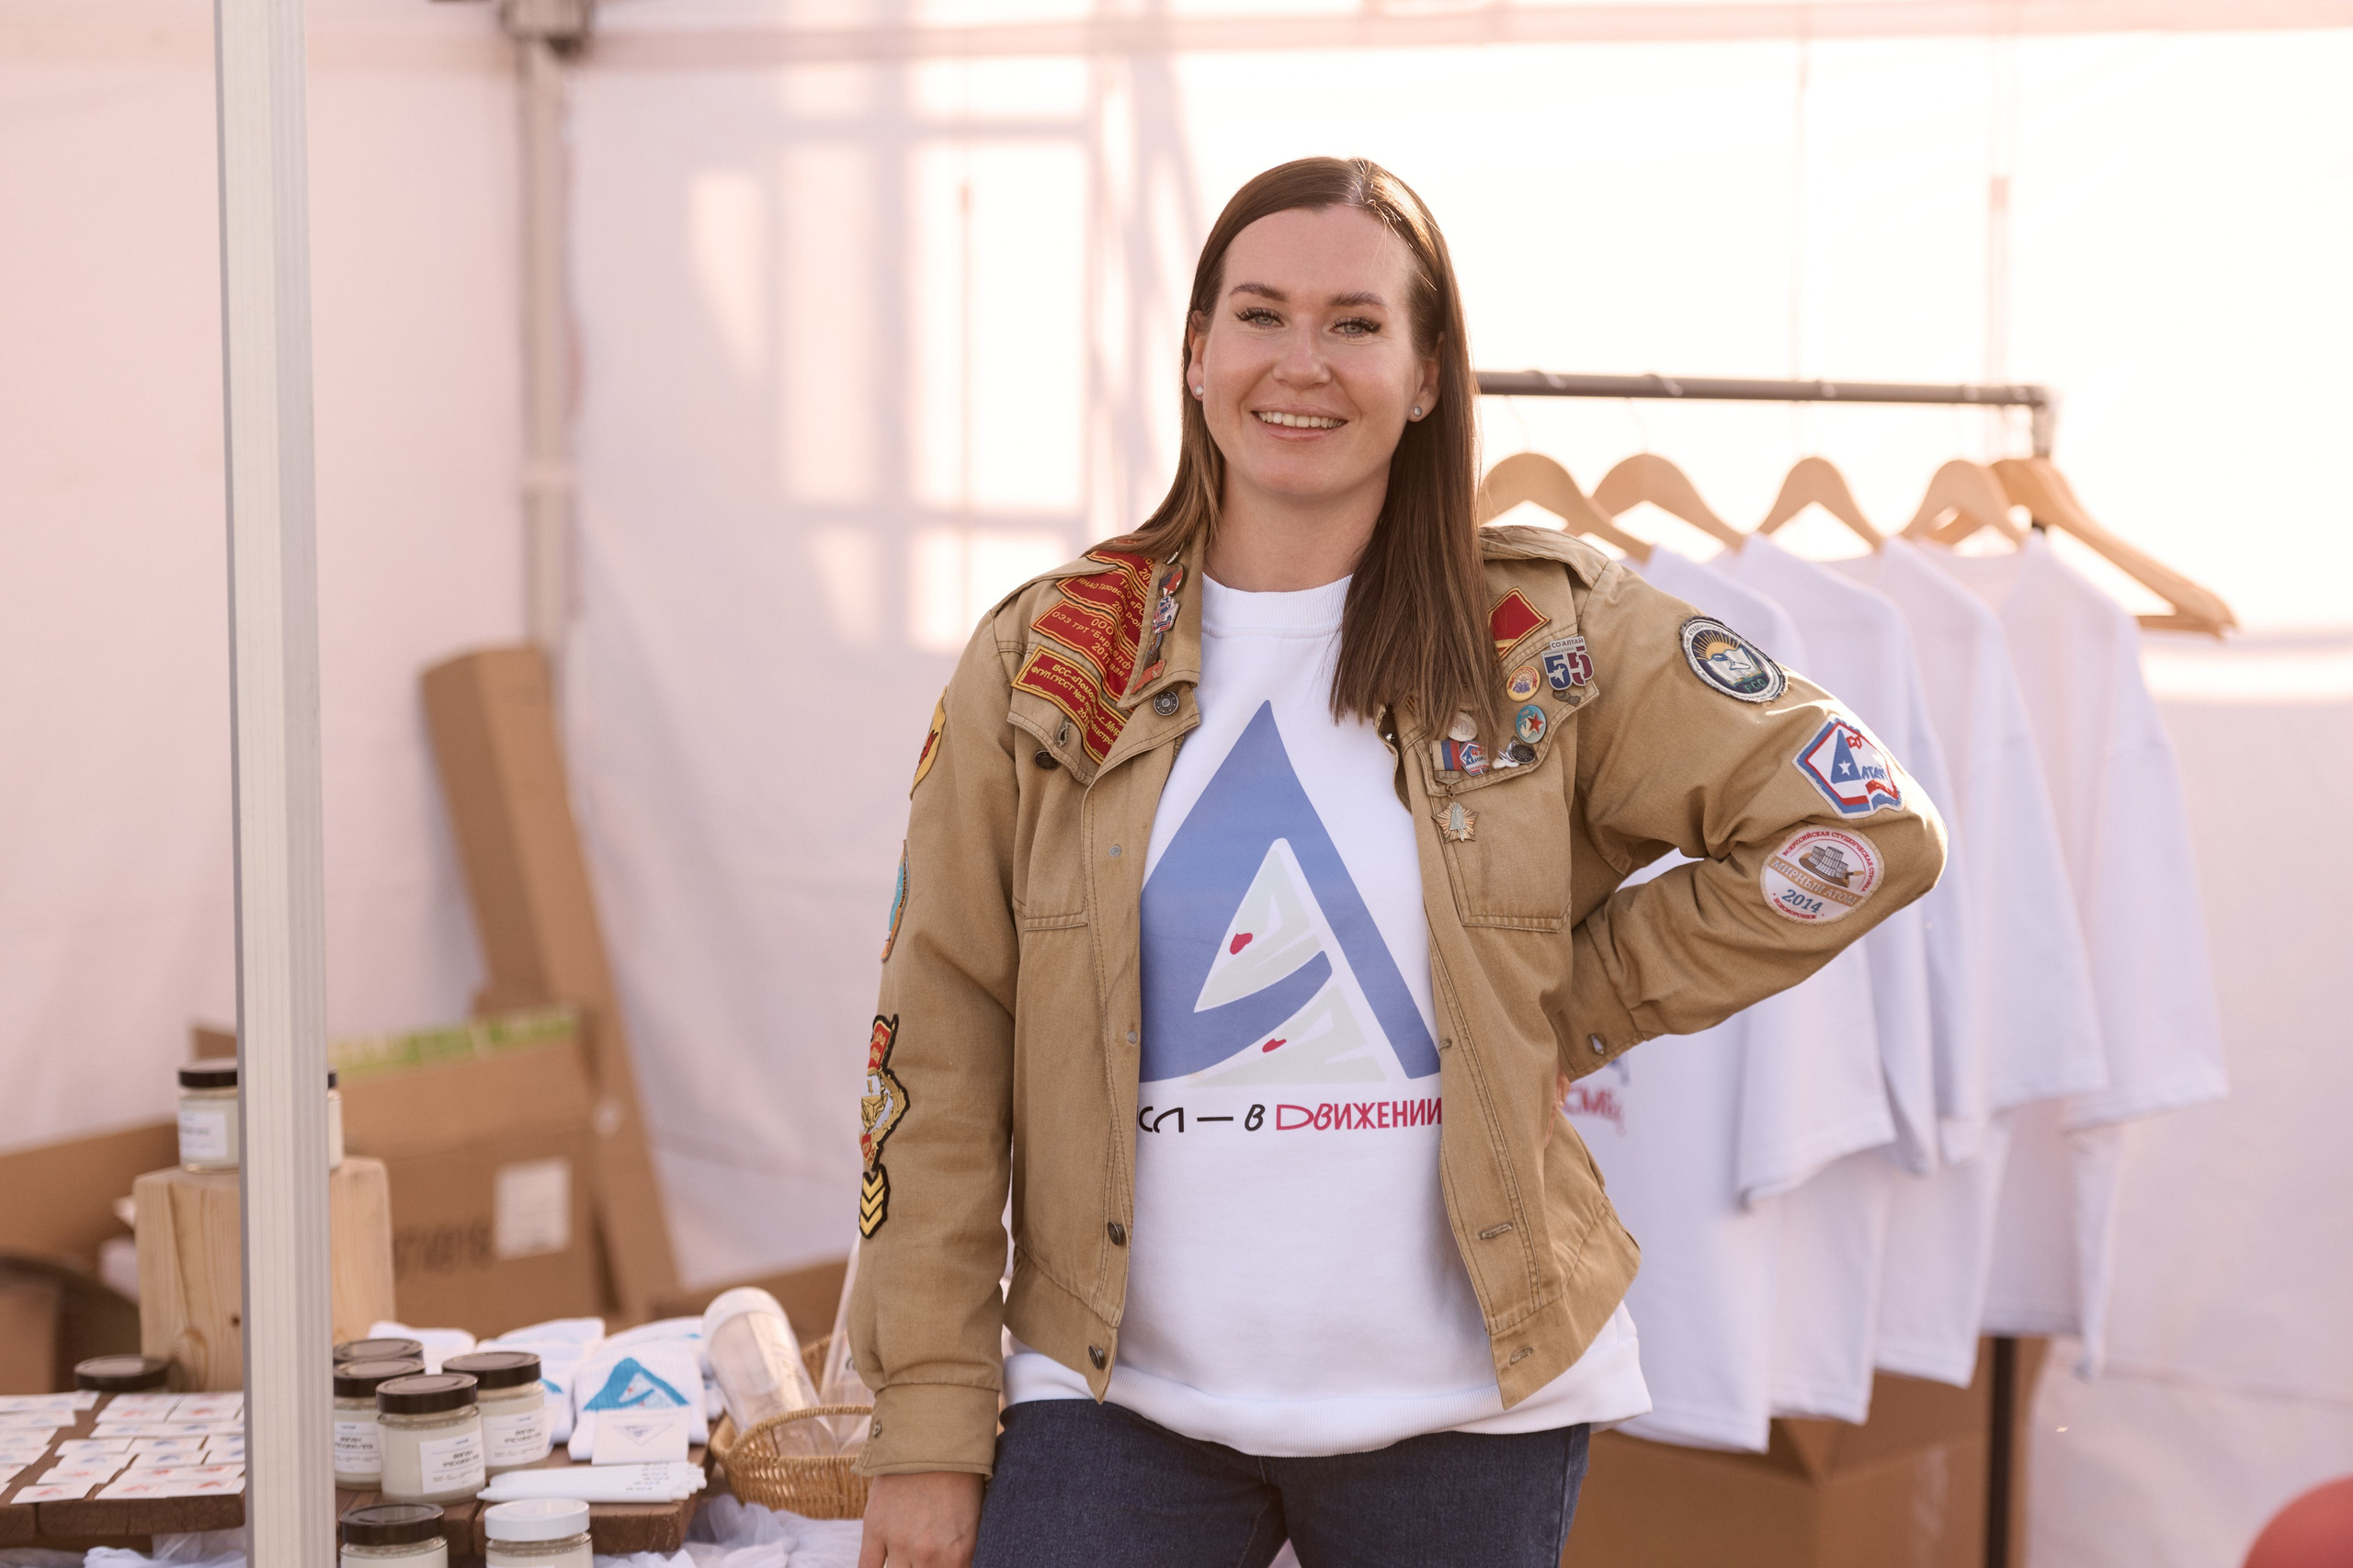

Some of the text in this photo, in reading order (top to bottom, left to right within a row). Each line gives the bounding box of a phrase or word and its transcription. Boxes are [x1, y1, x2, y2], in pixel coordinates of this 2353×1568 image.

[1051, 611, 1072, 623] ОЭЗ
[1073, 622, 1090, 633] ТРТ
[1091, 619, 1114, 636] ООО
[1552, 637, 1585, 649] СО АЛТАЙ
[1544, 645, 1593, 688] 55
[1744, 678, 1767, 693] РСО
[1782, 831, 1875, 892] ВСЕРОССИЙСКАЯ СТУДЕНЧЕСКАЯ СТРОЙКА
[1772, 860, 1858, 904] МИРНЫЙ АТОМ
[1781, 889, 1824, 913] 2014
[1276, 1097, 1441, 1131] ДВИЖЕНИИ
